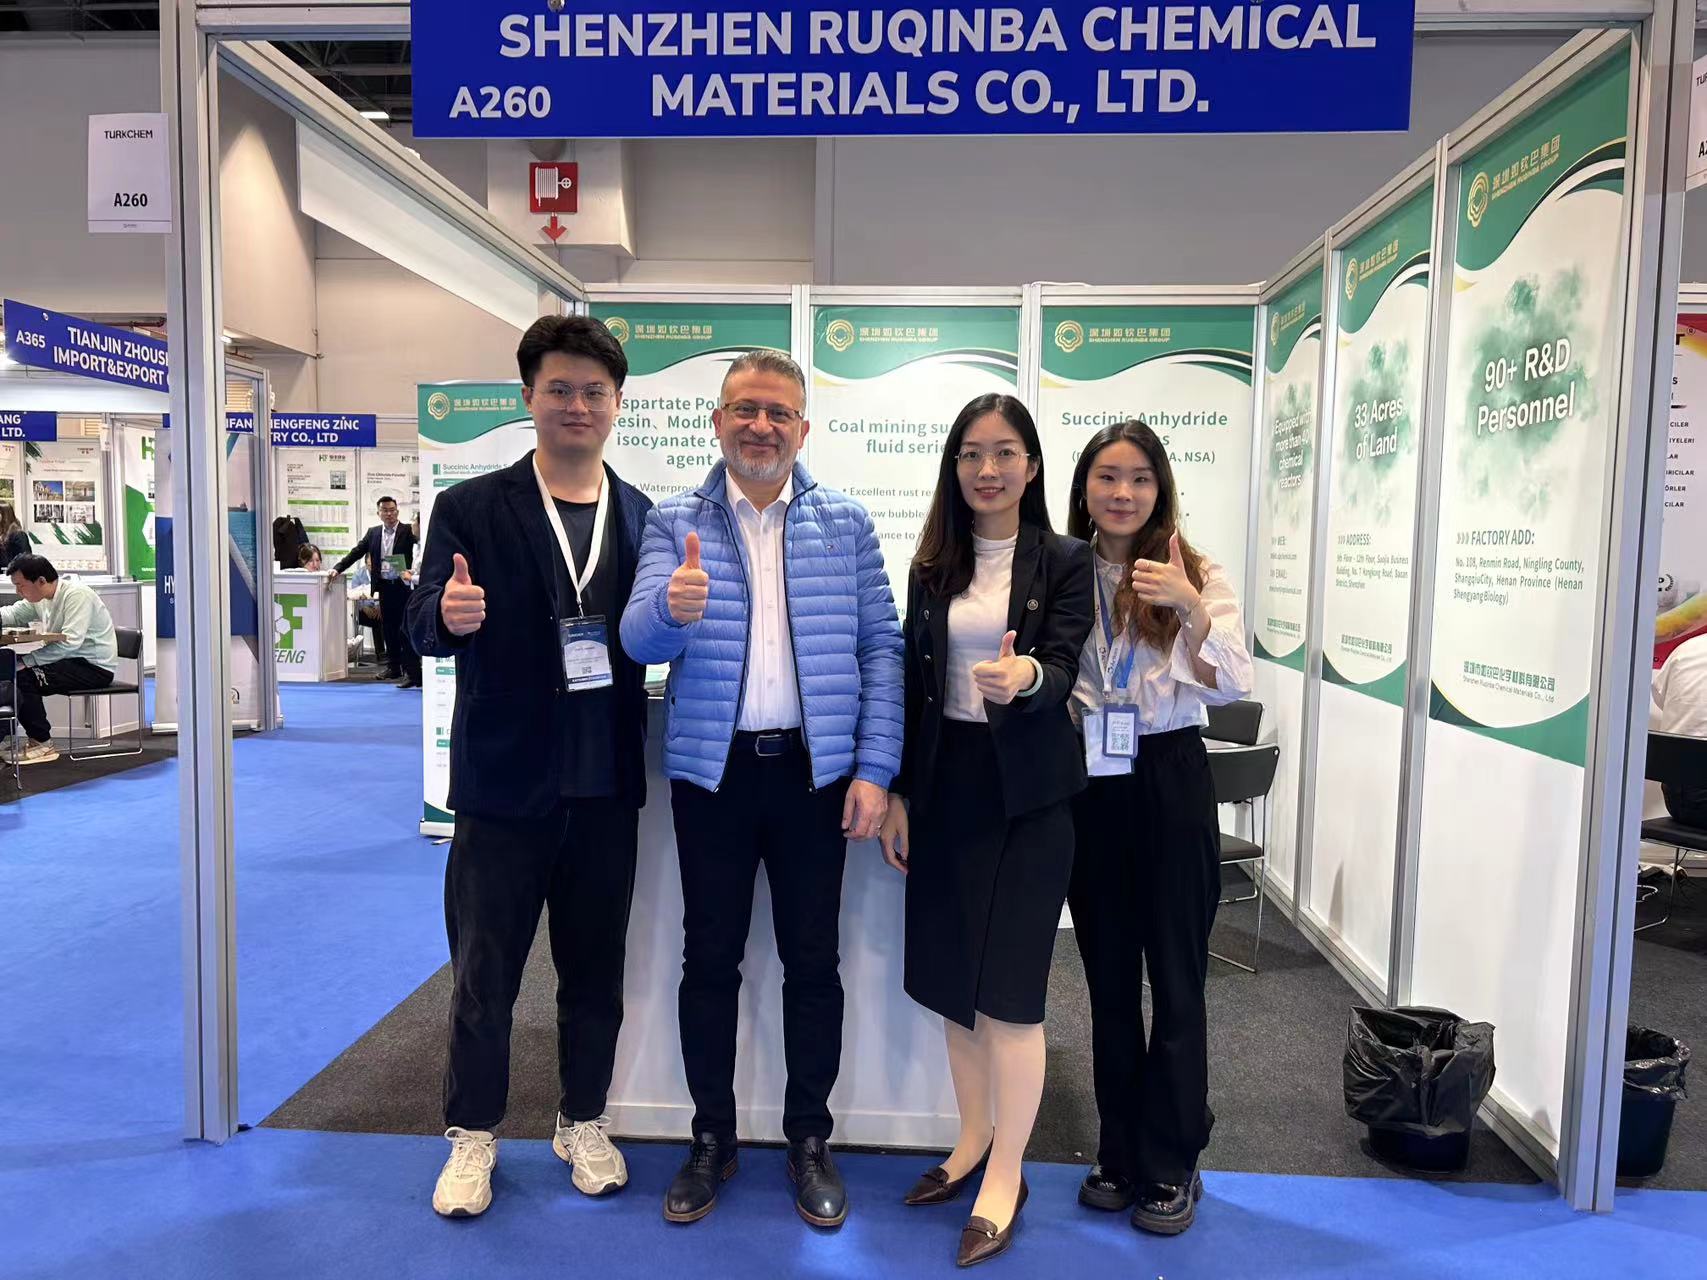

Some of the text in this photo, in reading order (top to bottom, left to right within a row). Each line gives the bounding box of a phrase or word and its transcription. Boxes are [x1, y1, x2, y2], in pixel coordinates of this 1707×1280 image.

[499, 4, 1376, 58] SHENZHEN RUQINBA CHEMICAL
[449, 85, 552, 119] A260
[652, 69, 1209, 124] MATERIALS CO., LTD.
[104, 129, 153, 139] TURKCHEM
[114, 193, 148, 207] A260
[15, 329, 46, 348] A365
[67, 326, 122, 355] TIANJIN
[53, 345, 165, 385] IMPORT&EXPORT
[1484, 338, 1571, 393] 90+ R&D
[1354, 397, 1404, 429] 33 Acres
[1476, 381, 1576, 436] Personnel
[332, 419, 360, 430] ZINC
[828, 419, 865, 433] Coal
[868, 419, 927, 437] mining
[1138, 411, 1228, 429] Anhydride
[1, 427, 26, 438] LTD.
[291, 432, 314, 445] CO.,
[317, 433, 339, 443] LTD
[617, 432, 706, 450] isocyanate
[866, 439, 904, 454] fluid
[1356, 427, 1398, 460] of Land
[666, 453, 713, 469] agent
[850, 487, 896, 497] Excellent
[898, 488, 919, 497] rust
[905, 531, 916, 540] to
[1346, 533, 1372, 546] ADDRESS:
[1471, 529, 1535, 546] FACTORY ADD:
[1479, 557, 1502, 568] Renmin
[1503, 557, 1521, 571] Road,
[1523, 556, 1553, 573] Ningling
[1555, 558, 1584, 573] County,
[1496, 574, 1517, 586] Henan
[1519, 575, 1551, 588] Province
[1554, 576, 1583, 590] (Henan
